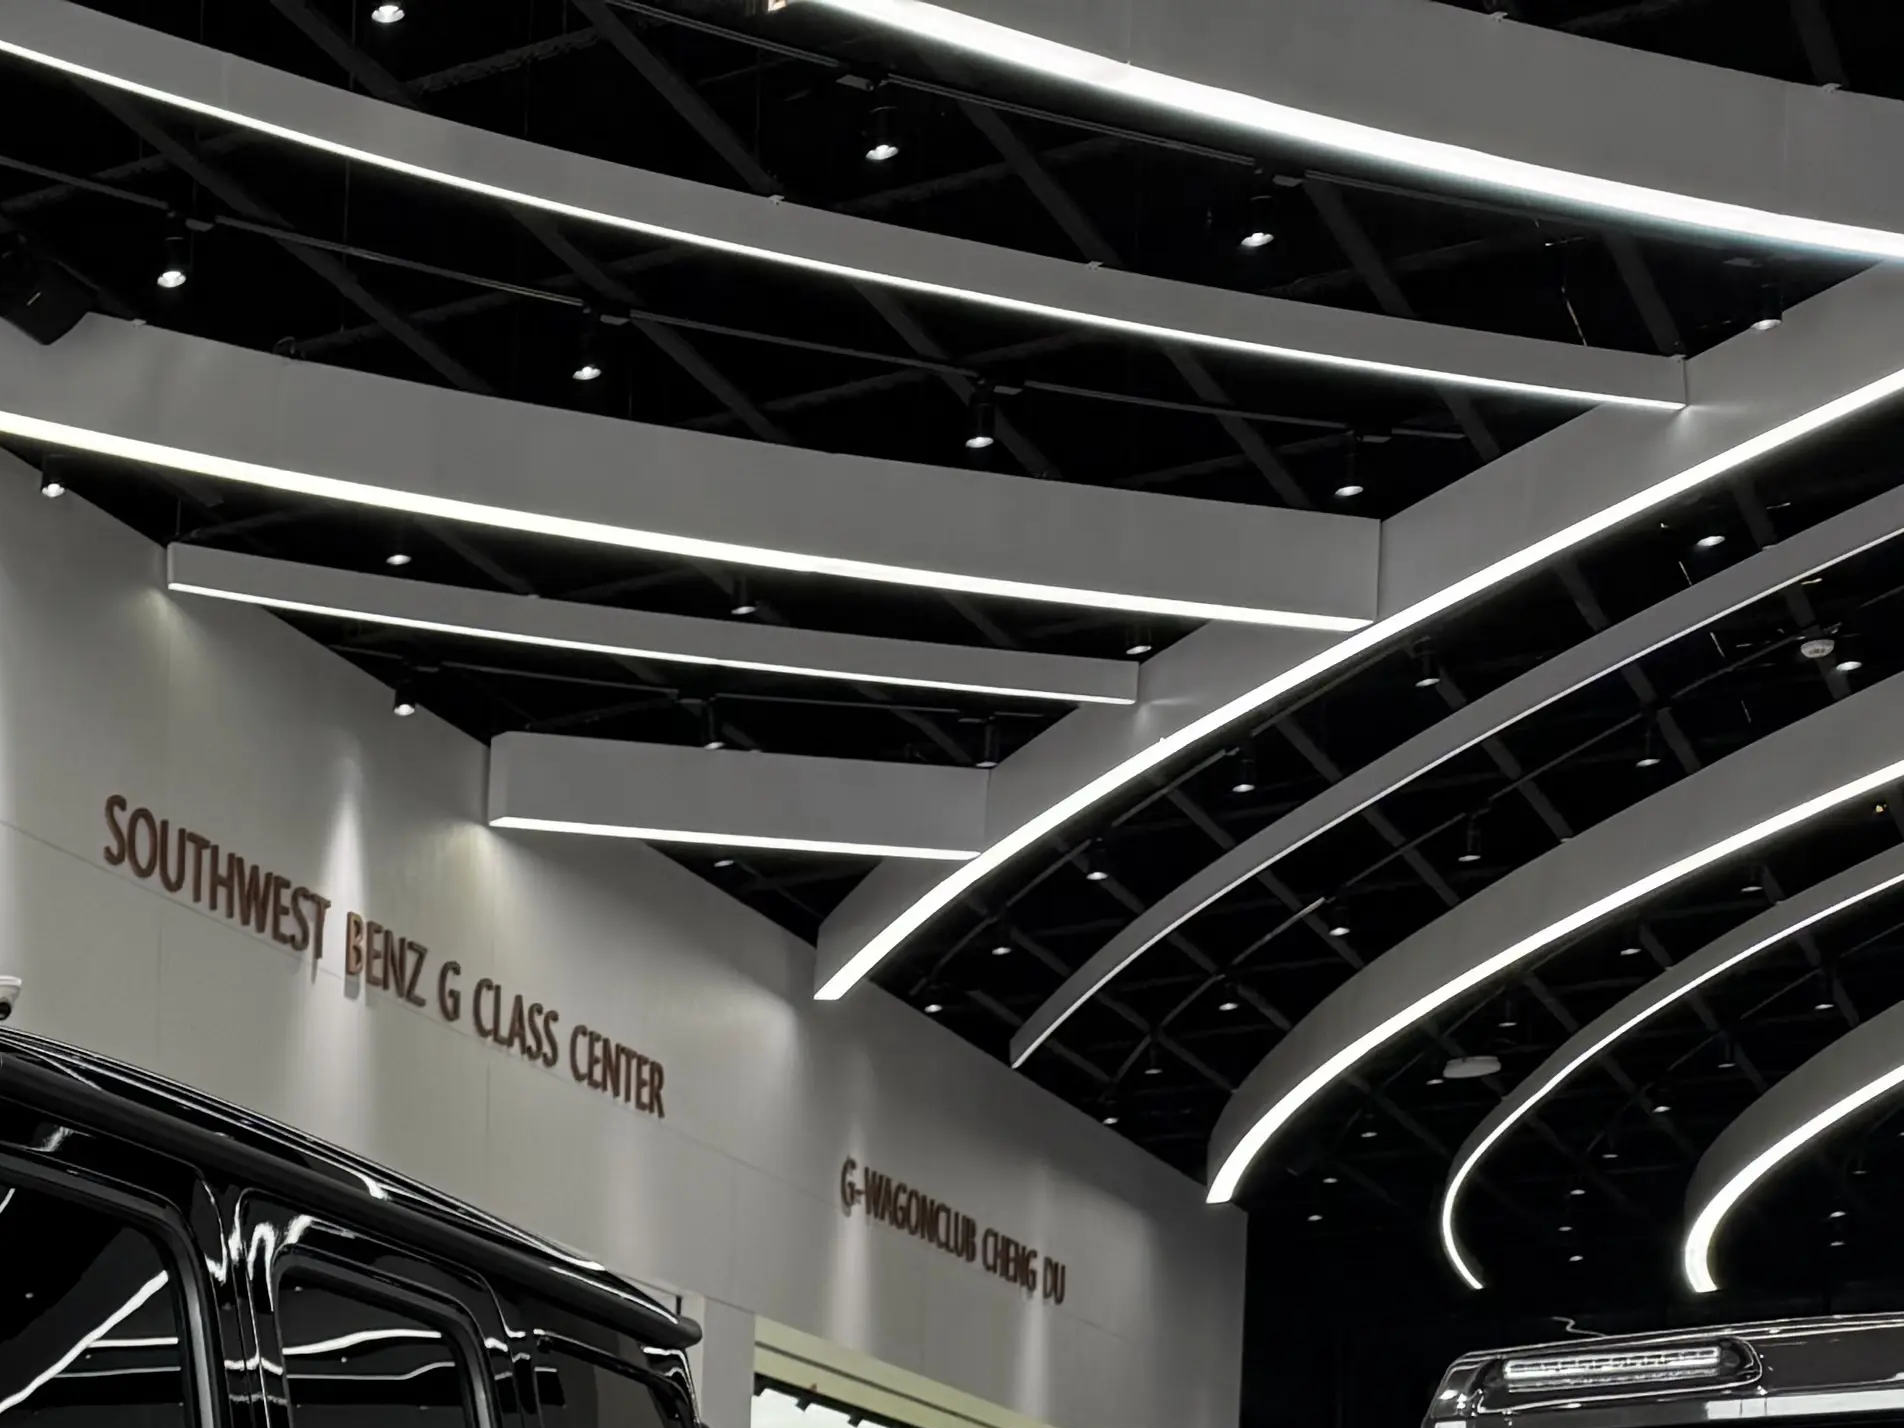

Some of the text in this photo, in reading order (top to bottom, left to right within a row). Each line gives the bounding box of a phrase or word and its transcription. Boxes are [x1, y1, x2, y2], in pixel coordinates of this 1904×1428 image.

[103, 794, 666, 1119] SOUTHWEST BENZ G CLASS CENTER
[982, 1227, 1038, 1293] CHENG
[1042, 1256, 1066, 1305] DU
